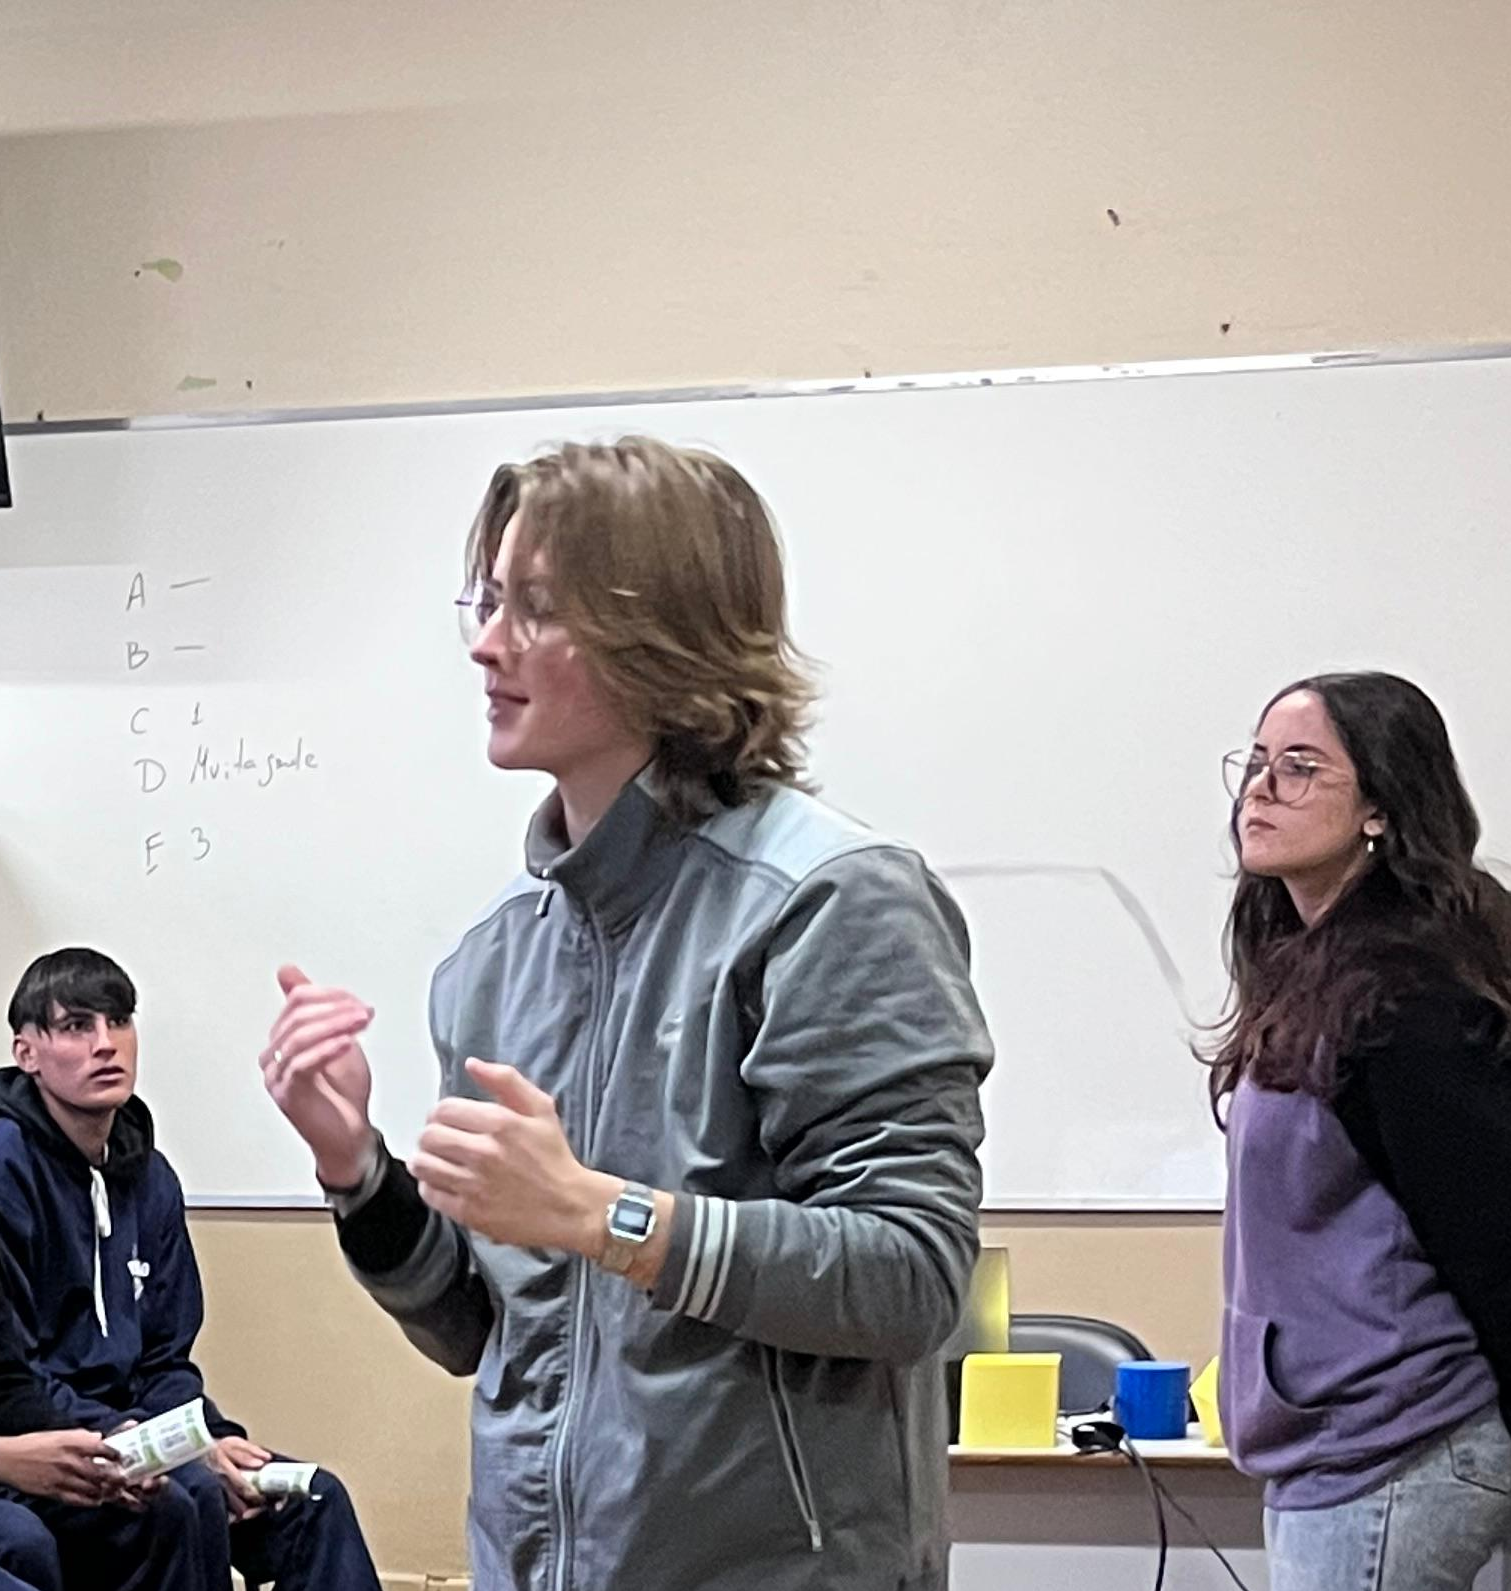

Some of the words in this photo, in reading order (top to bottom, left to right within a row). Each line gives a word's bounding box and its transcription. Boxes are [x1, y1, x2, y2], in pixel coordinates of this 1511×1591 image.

[126, 572, 145, 611] A
[128, 641, 149, 670] B
[130, 707, 150, 734] C
[134, 758, 167, 792] D
[191, 827, 211, 861] 3
